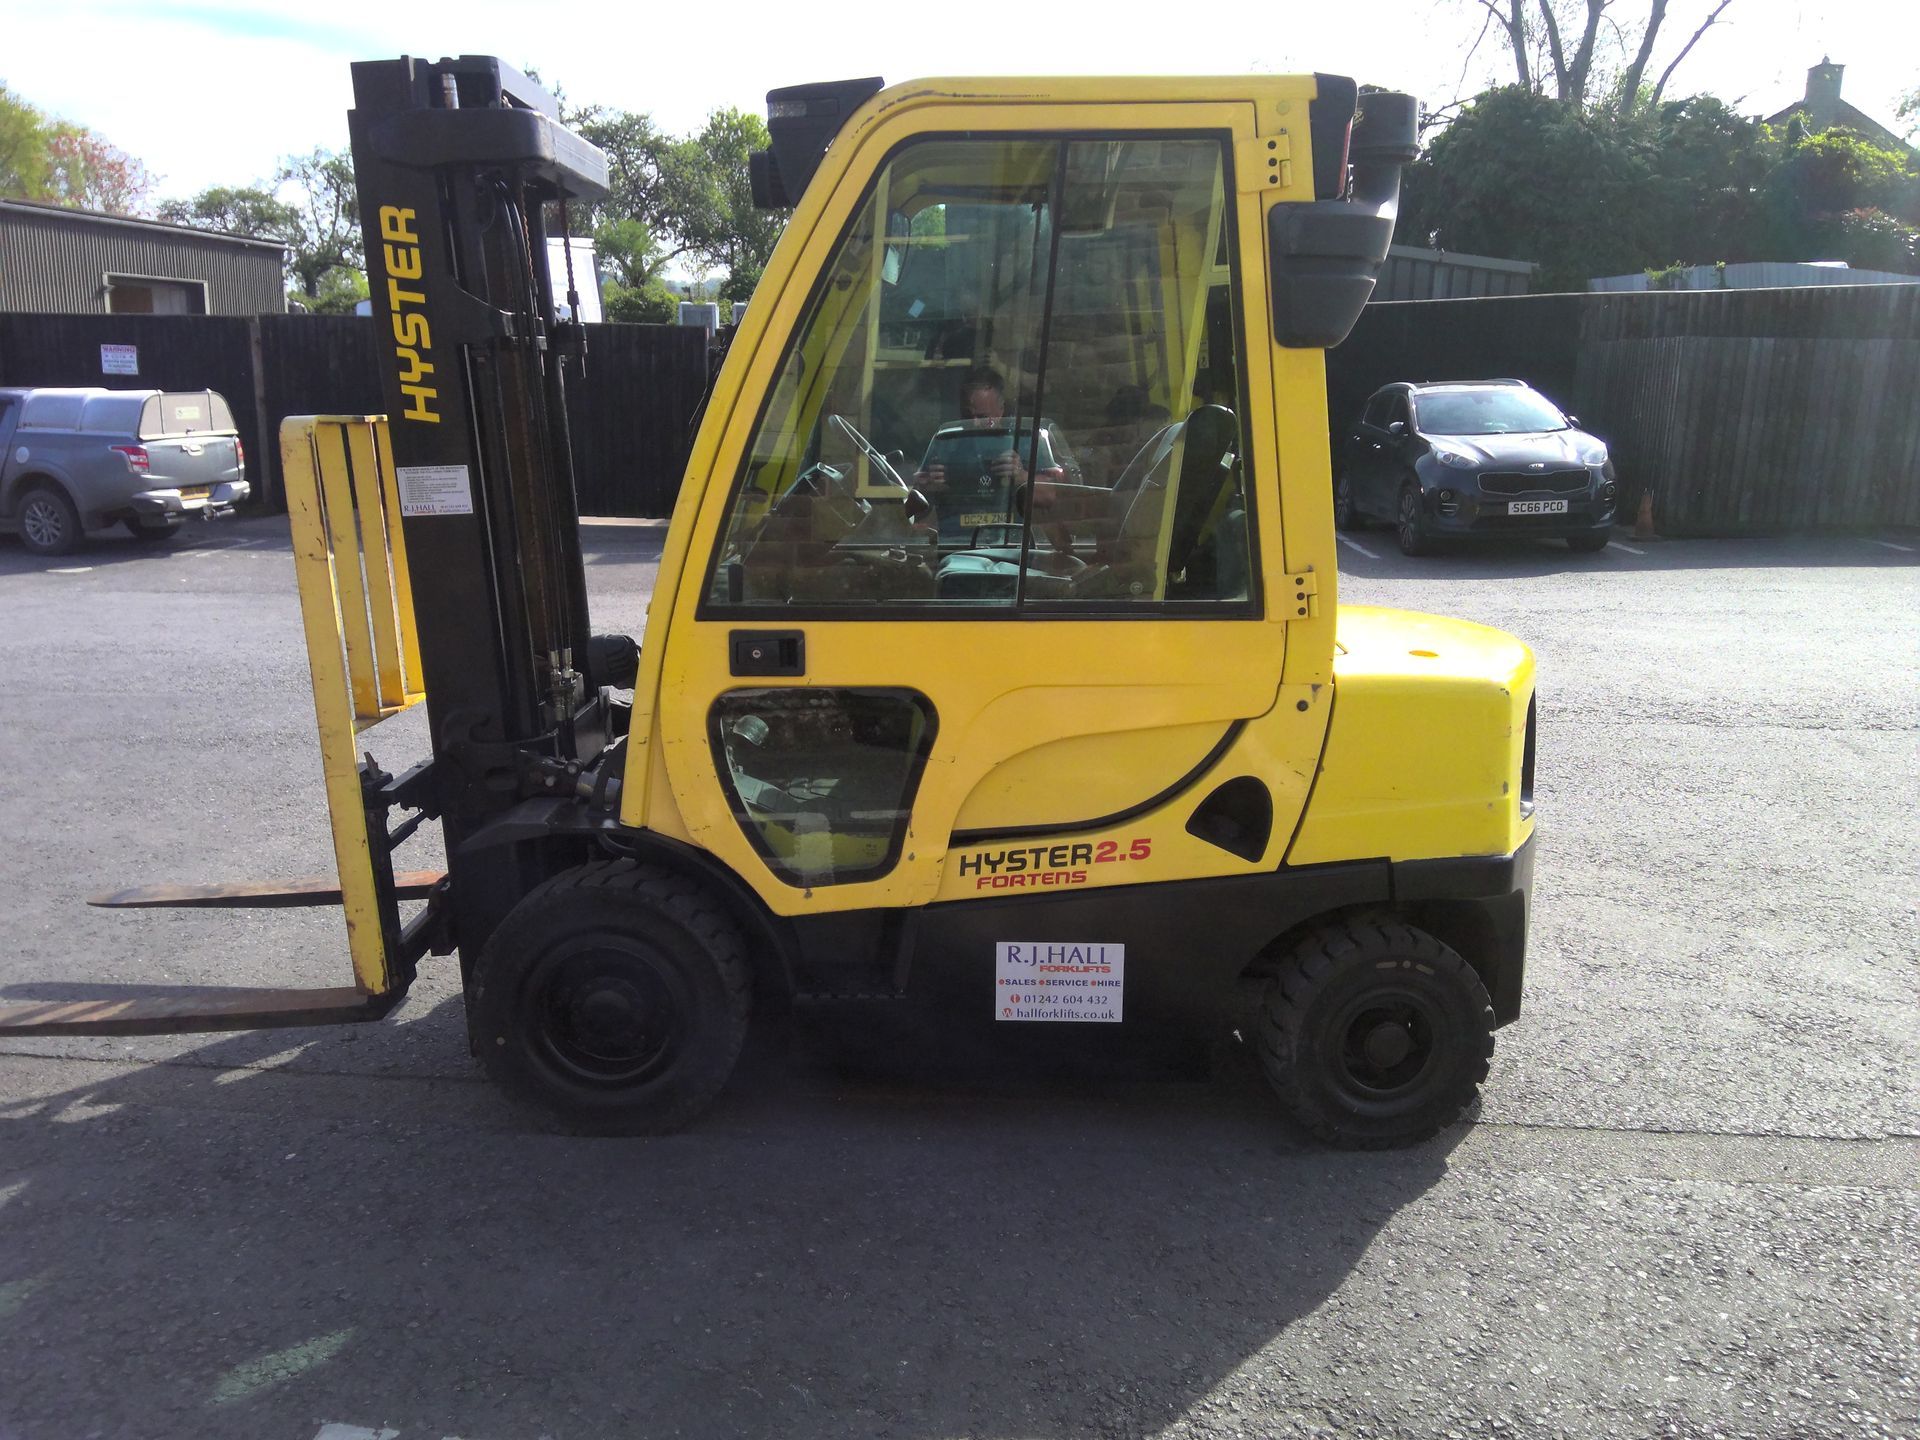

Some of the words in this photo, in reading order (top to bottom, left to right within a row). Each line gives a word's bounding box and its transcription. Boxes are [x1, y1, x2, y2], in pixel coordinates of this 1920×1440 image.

[379, 205, 440, 423] HYSTER
[1513, 503, 1540, 513] SC66
[1543, 501, 1563, 512] PCO
[959, 843, 1093, 876] HYSTER
[1095, 838, 1152, 863] 2.5
[976, 870, 1087, 889] FORTENS
[1039, 965, 1111, 973] FORKLIFTS
[1046, 979, 1089, 987] SERVICE
[1024, 994, 1059, 1004] 01242
[1062, 995, 1083, 1004] 604
[1087, 995, 1108, 1005] 432
[1016, 1008, 1115, 1019] hallforklifts.co.uk
